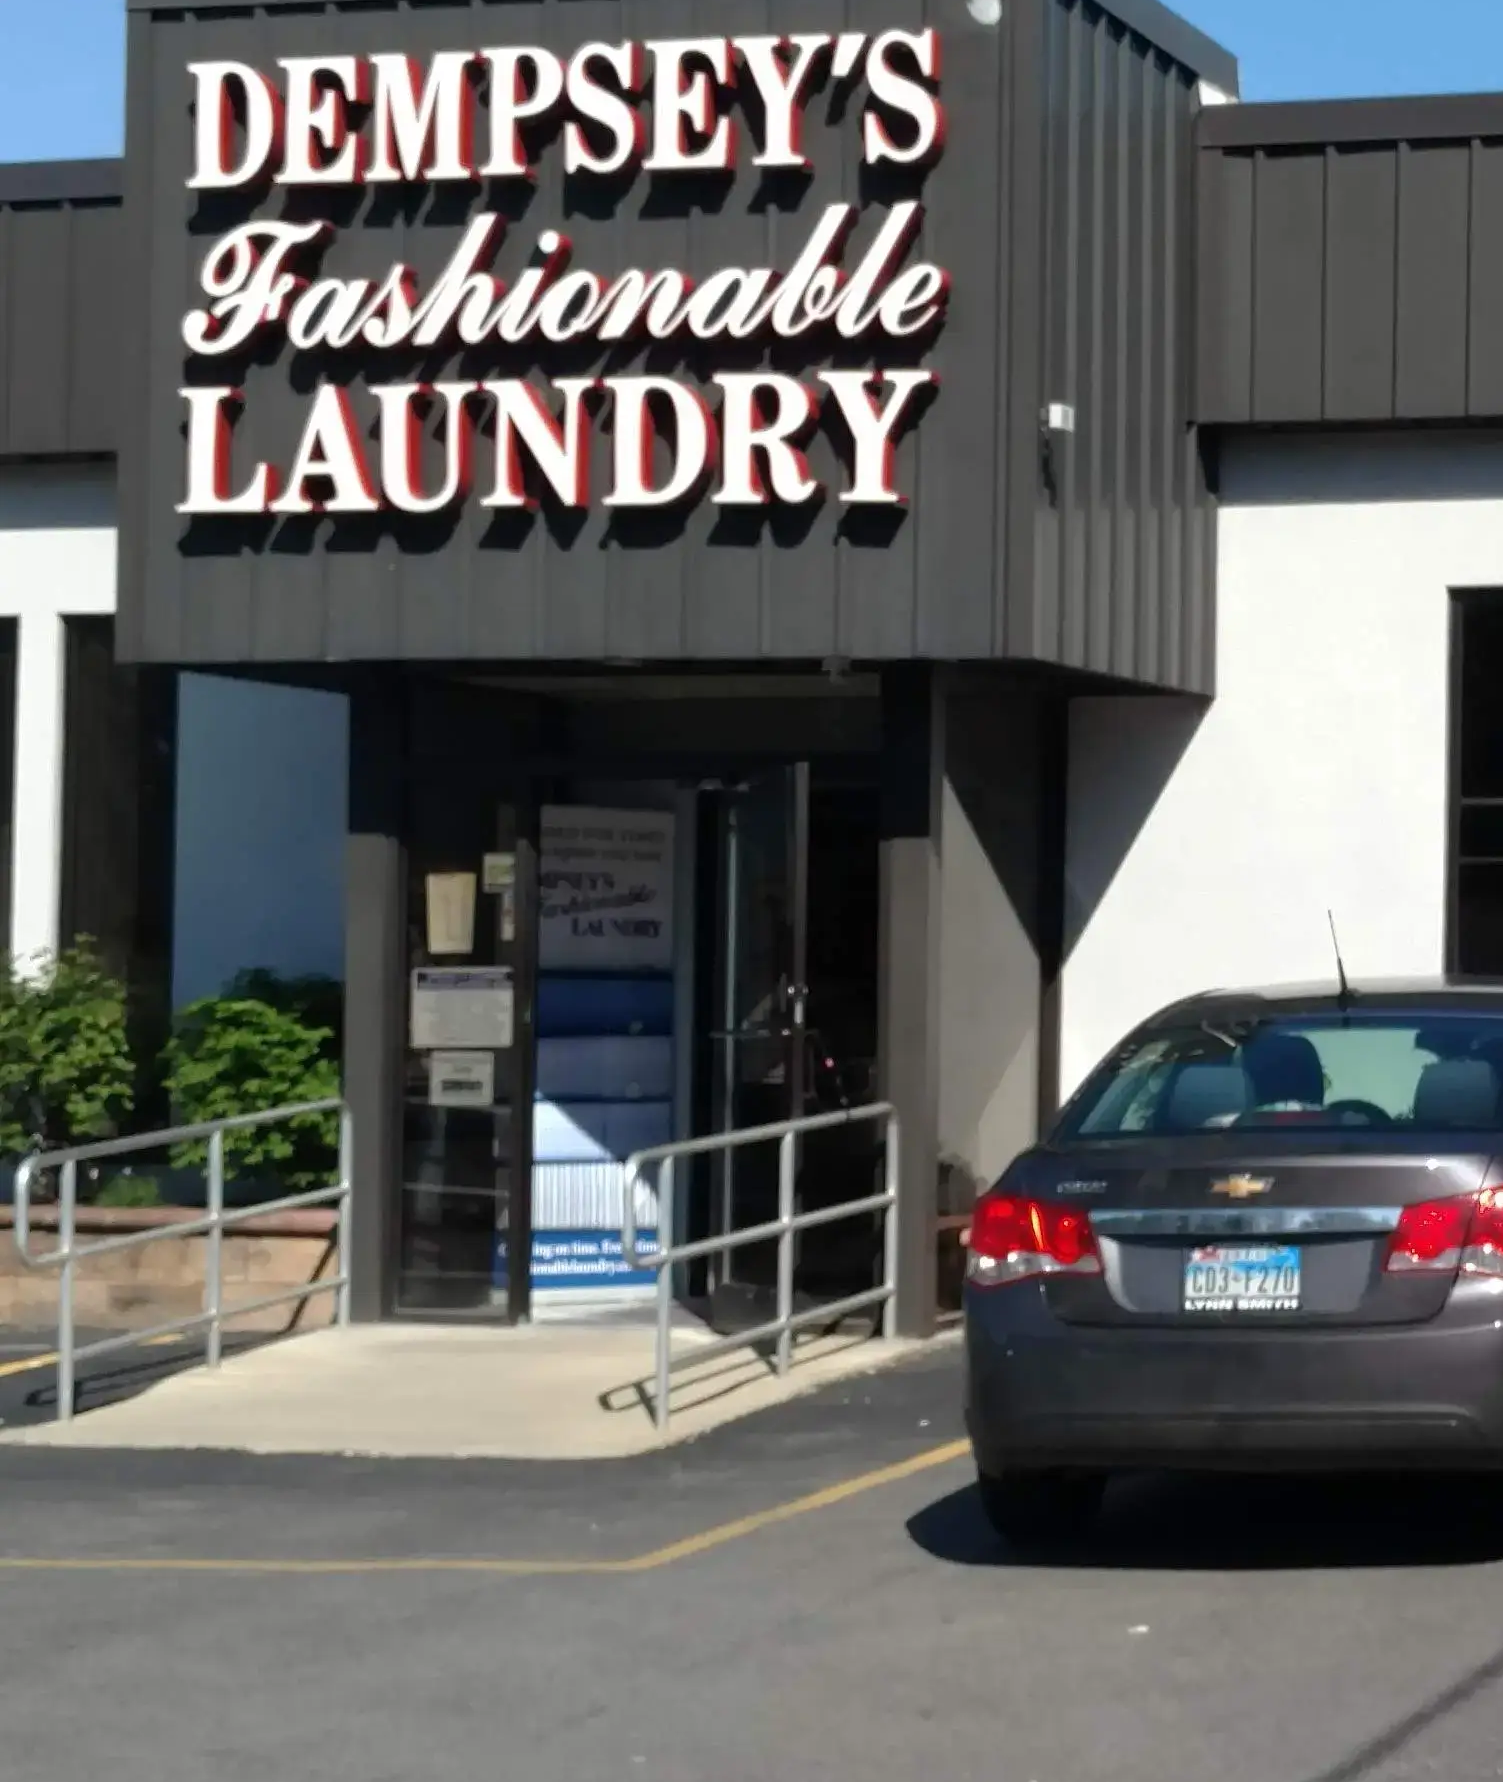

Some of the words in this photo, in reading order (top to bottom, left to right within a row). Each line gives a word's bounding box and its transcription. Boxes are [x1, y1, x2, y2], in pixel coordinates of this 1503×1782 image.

[185, 28, 948, 189] DEMPSEY'S
[182, 201, 949, 355] Fashionable
[175, 370, 939, 515] LAUNDRY
